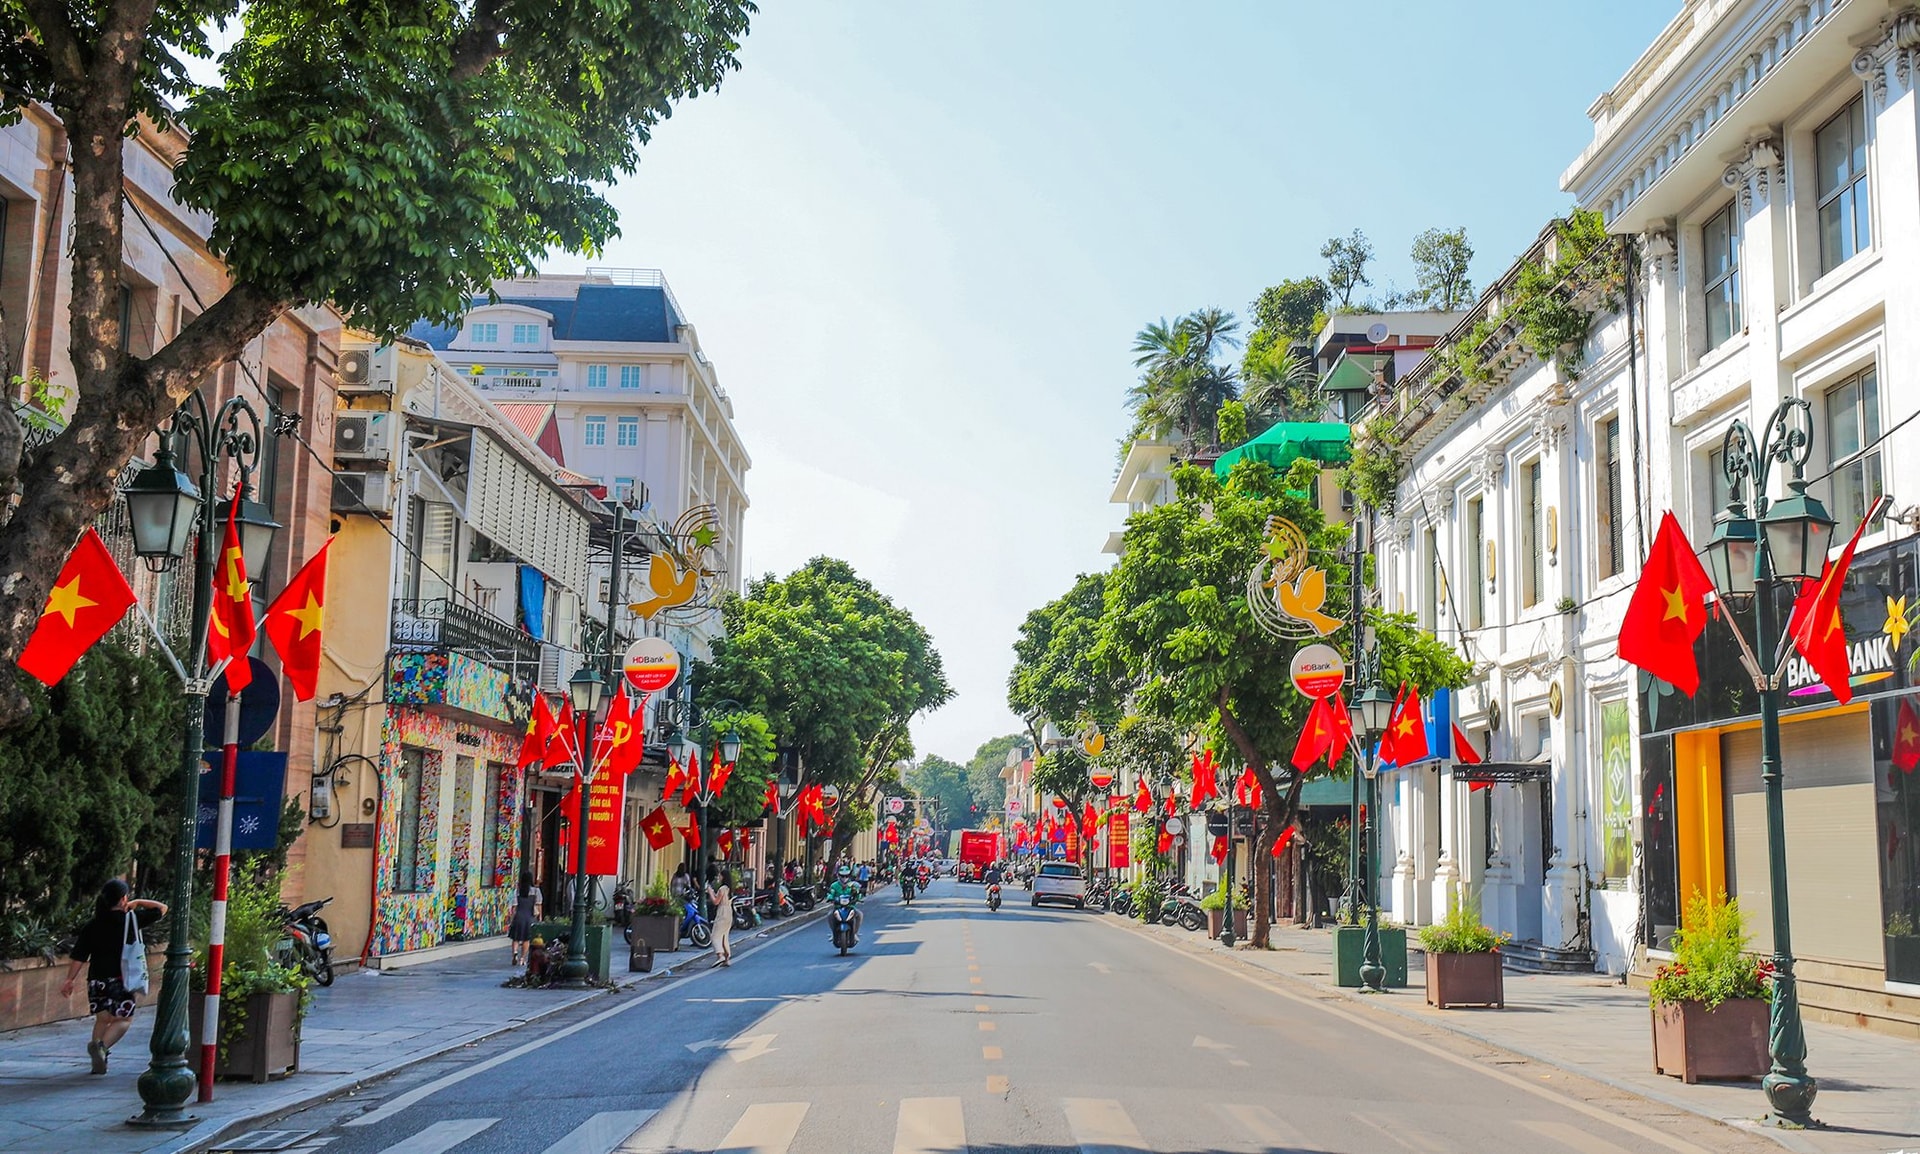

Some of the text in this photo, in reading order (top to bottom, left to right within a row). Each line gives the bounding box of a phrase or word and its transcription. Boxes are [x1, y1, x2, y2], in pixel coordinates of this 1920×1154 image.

[632, 656, 665, 664] HDBank
[1301, 663, 1331, 672] HDBank
[362, 798, 375, 816] 9
